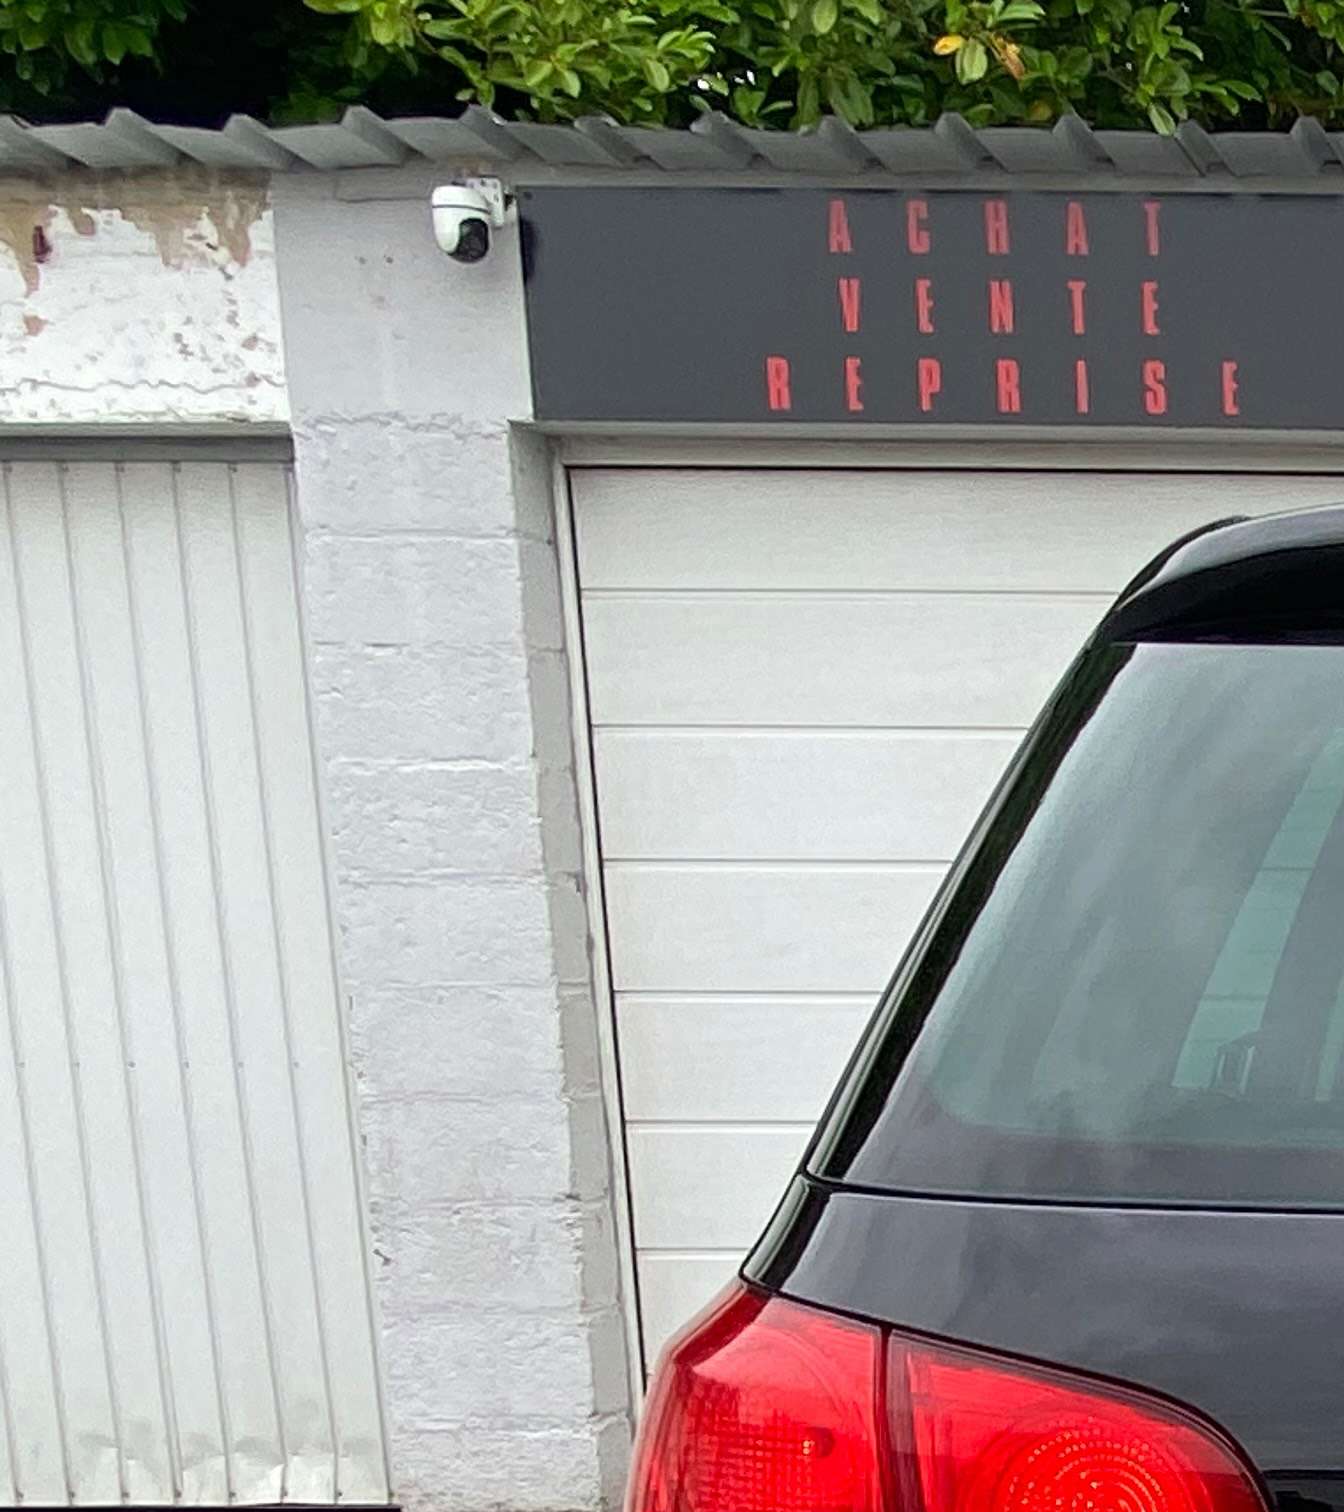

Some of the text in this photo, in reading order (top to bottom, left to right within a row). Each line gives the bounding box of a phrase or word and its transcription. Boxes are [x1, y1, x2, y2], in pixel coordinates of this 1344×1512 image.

[828, 199, 1161, 256] ACHAT
[837, 277, 1161, 336] VENTE
[766, 355, 1240, 416] REPRISE
